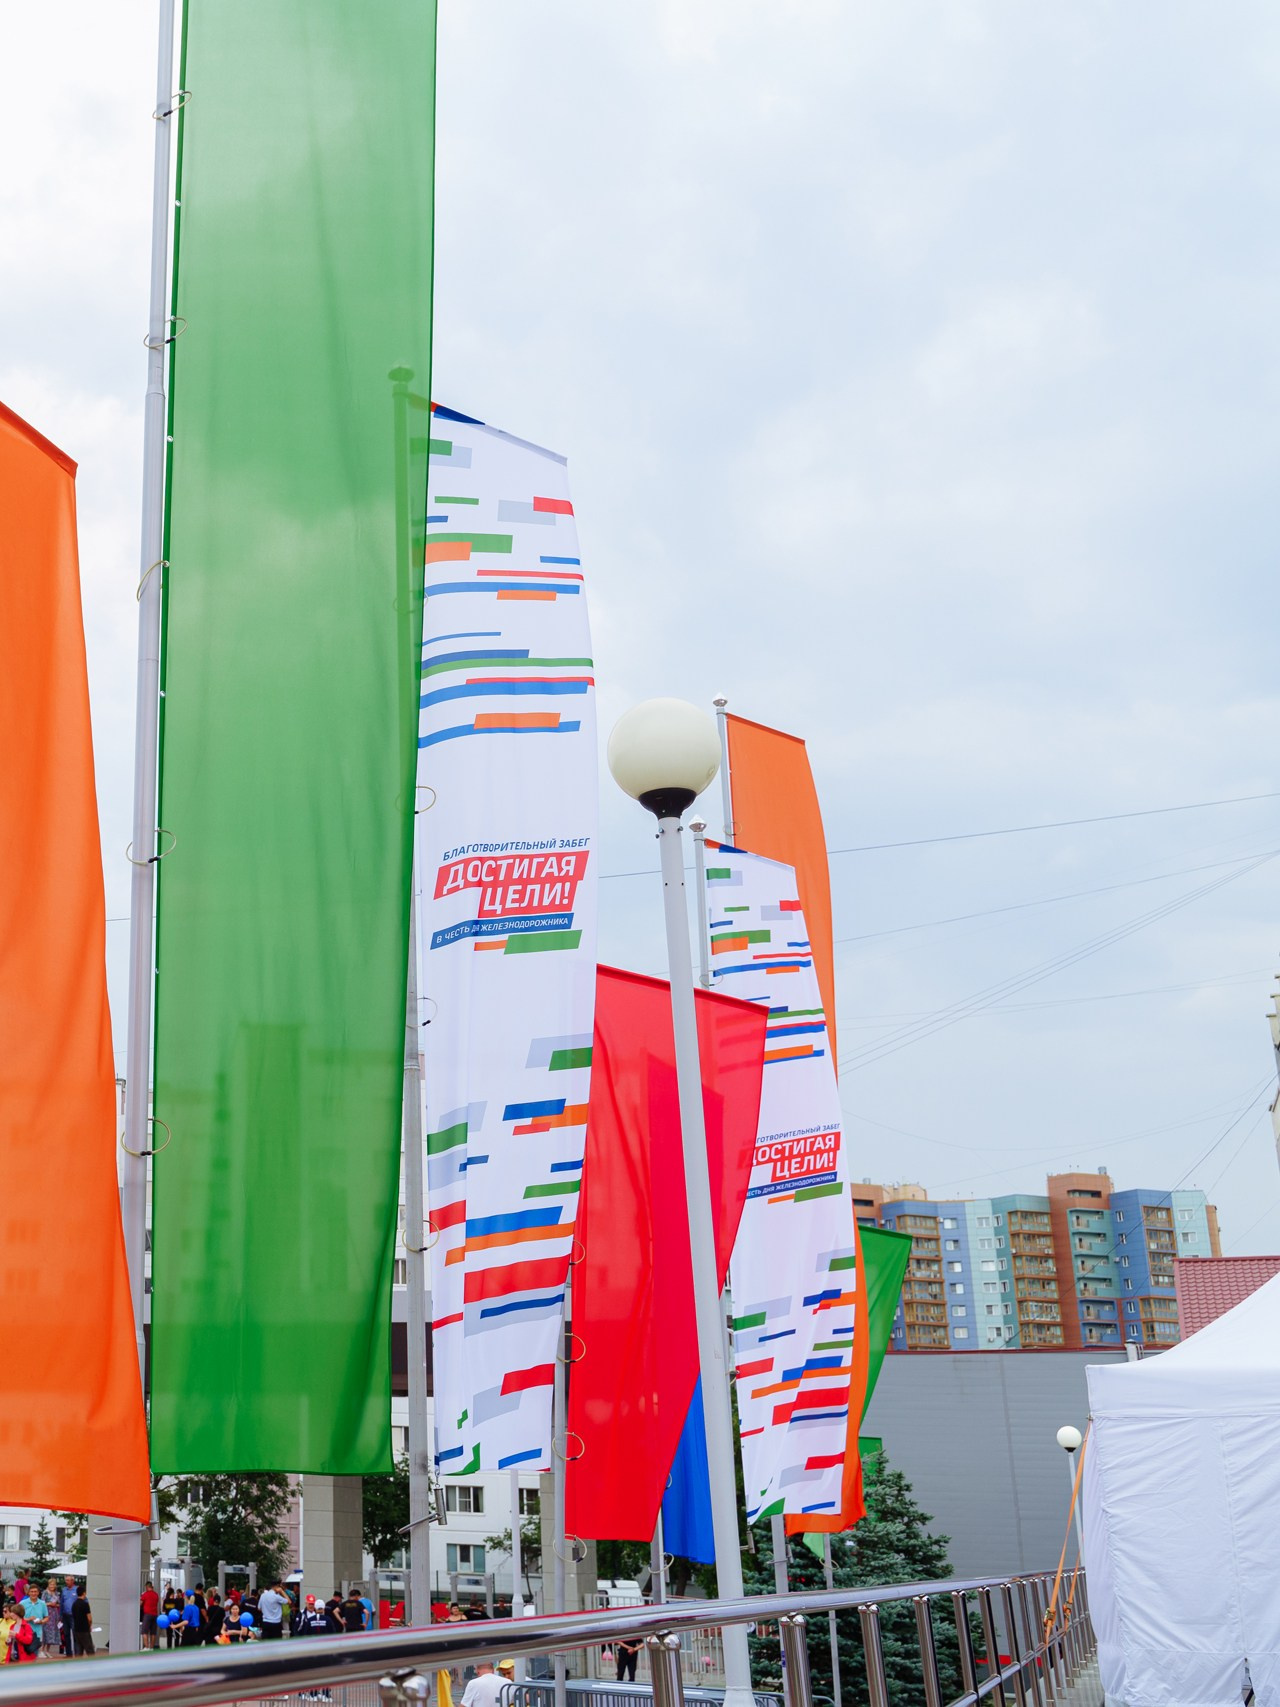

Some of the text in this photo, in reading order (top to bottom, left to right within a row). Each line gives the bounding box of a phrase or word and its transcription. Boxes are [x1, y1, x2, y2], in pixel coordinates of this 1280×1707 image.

[443, 837, 590, 861] БЛАГОТВОРИТЕЛЬНЫЙ ЗАБЕГ
[442, 855, 576, 895] ДОСТИГАЯ
[483, 881, 571, 914] ЦЕЛИ!
[436, 935, 443, 944] В
[444, 926, 470, 941] ЧЕСТЬ
[480, 917, 568, 932] ЖЕЛЕЗНОДОРОЖНИКА
[756, 1123, 840, 1144] ГОТВОРИТЕЛЬНЫЙ ЗАБЕГ
[753, 1134, 835, 1166] ОСТИГАЯ
[775, 1151, 834, 1178] ЦЕЛИ!
[762, 1186, 775, 1194] ДНЯ
[775, 1174, 835, 1191] ЖЕЛЕЗНОДОРОЖНИКА
